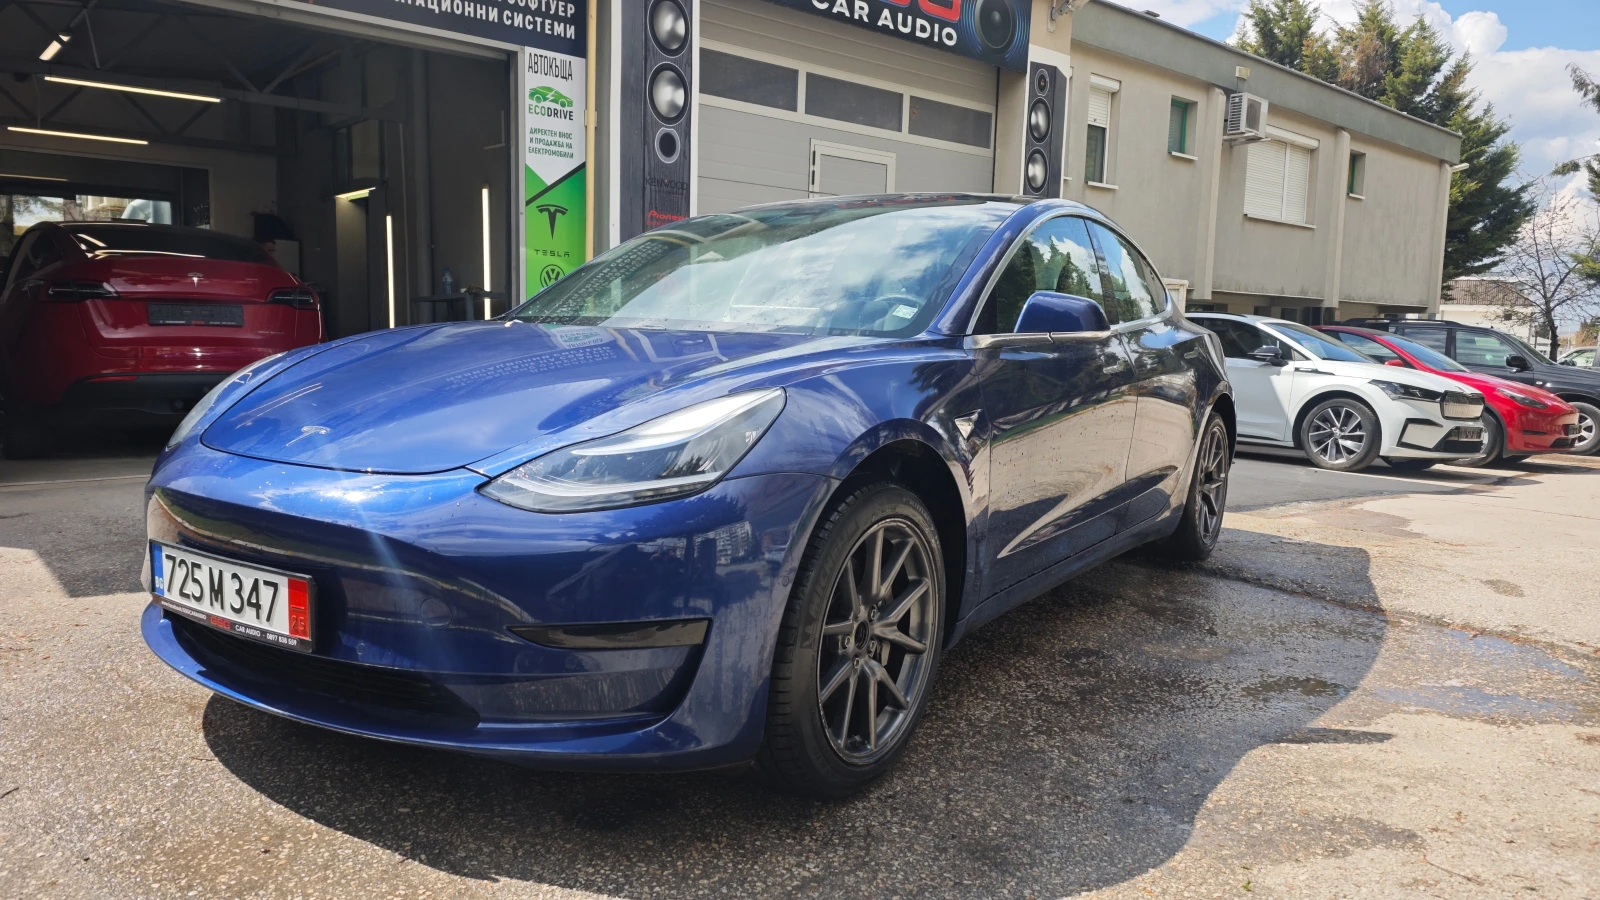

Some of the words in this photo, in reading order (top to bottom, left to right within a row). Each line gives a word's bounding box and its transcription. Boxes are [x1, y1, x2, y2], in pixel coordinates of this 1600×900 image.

[508, 0, 575, 18] ФТУЕР
[503, 9, 575, 40] СИСТЕМИ
[877, 8, 958, 47] AUDIO
[528, 52, 573, 82] АВТОКЪЩА
[528, 104, 574, 121] ECODRIVE
[529, 127, 558, 138] ДИРЕКТЕН
[558, 131, 573, 140] ВНОС
[534, 137, 564, 149] ПРОДАЖБА
[565, 141, 573, 150] НА
[528, 146, 574, 159] ЕЛЕКТРОМОБИЛИ
[645, 177, 688, 191] KENWOOD
[648, 210, 686, 222] Pionee
[534, 248, 570, 258] TESLA
[155, 576, 164, 589] BG
[235, 624, 246, 633] CAR
[246, 628, 261, 637] AUDIO
